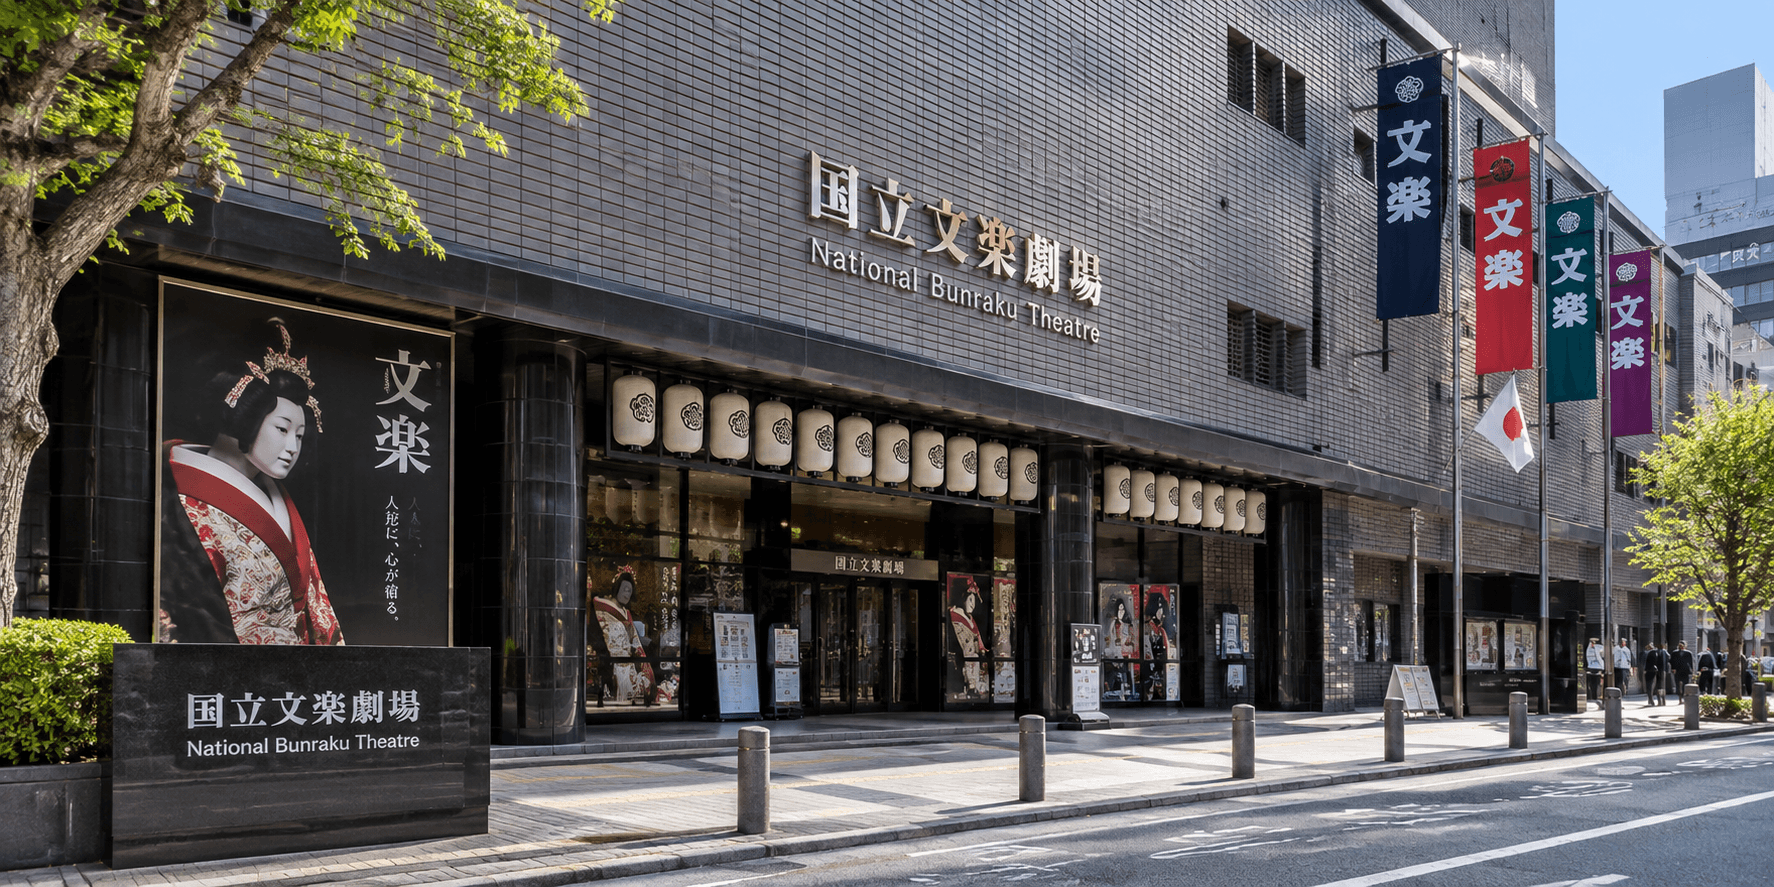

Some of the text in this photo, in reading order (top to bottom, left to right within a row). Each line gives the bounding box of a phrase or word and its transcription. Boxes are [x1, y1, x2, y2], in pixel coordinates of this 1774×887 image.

[1386, 119, 1432, 224] 文楽
[808, 150, 1103, 307] 国立文楽劇場
[1483, 198, 1524, 292] 文楽
[810, 237, 1100, 344] National Bunraku Theatre
[1551, 247, 1588, 329] 文楽
[1610, 294, 1645, 370] 文楽
[375, 349, 431, 474] 文楽
[187, 689, 421, 730] 国立文楽劇場
[187, 733, 420, 757] National Bunraku Theatre
